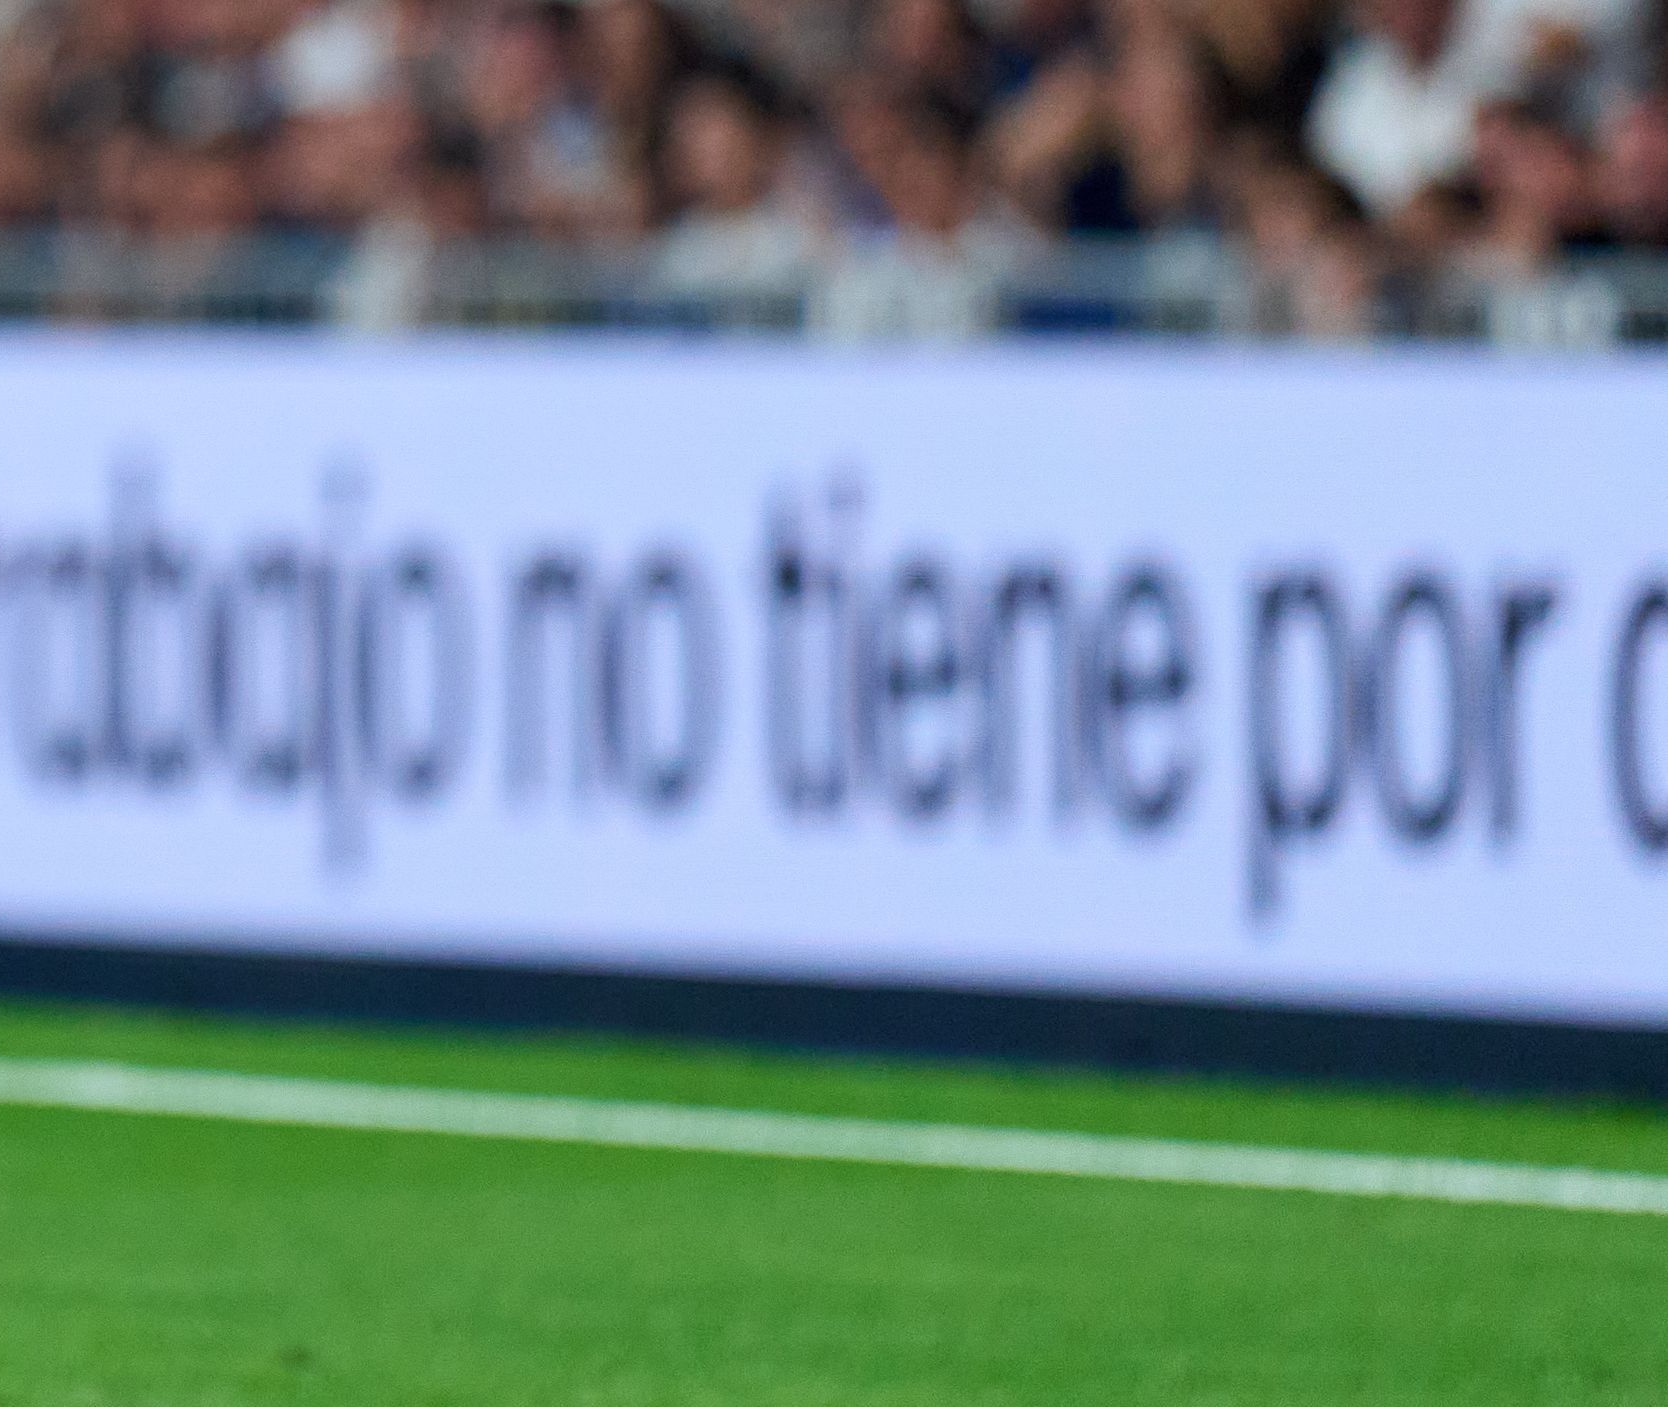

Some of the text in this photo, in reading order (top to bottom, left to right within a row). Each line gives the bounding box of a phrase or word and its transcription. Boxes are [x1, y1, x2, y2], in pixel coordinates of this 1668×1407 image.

[502, 540, 719, 810] no
[764, 464, 1196, 832] tiene
[1248, 562, 1560, 922] por
